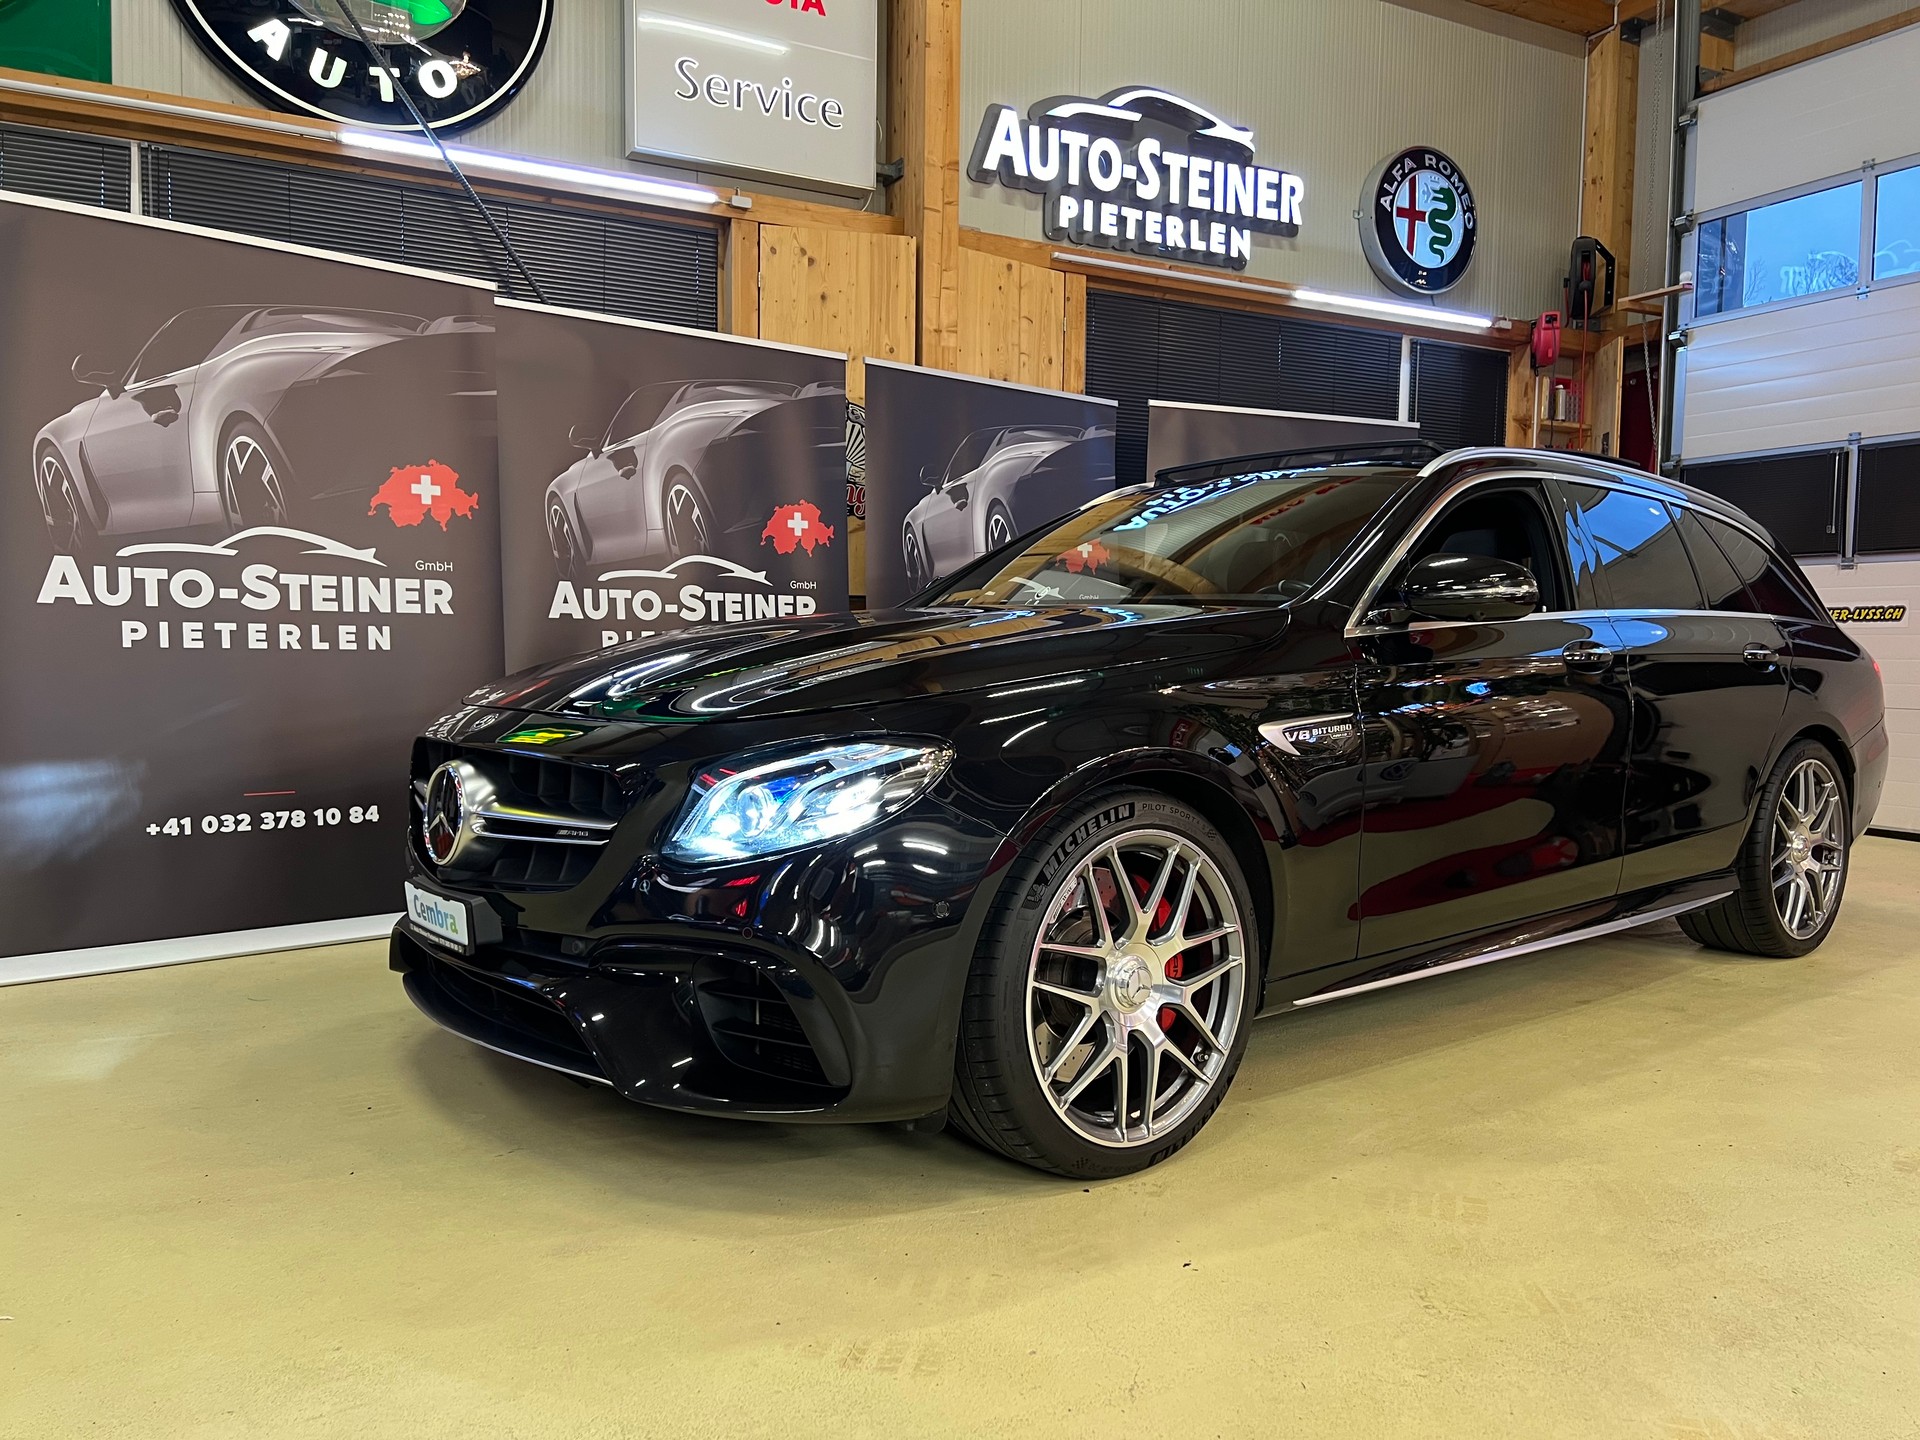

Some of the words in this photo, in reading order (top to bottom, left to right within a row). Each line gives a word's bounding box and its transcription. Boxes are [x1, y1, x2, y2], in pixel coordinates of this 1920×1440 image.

[247, 18, 458, 103] AUTO
[675, 56, 843, 130] Service
[982, 107, 1304, 226] AUTO-STEINER
[1380, 157, 1417, 212] ALFA
[1424, 154, 1474, 230] ROMEO
[1058, 196, 1252, 261] PIETERLEN
[36, 554, 455, 616] AUTO-STEINER
[415, 559, 454, 572] GmbH
[789, 580, 817, 590] GmbH
[121, 620, 391, 650] PIETERLEN
[1284, 730, 1310, 742] V8
[1312, 723, 1352, 736] BITURBO
[146, 816, 192, 837] +41
[202, 814, 251, 834] 032
[260, 810, 306, 831] 378
[313, 807, 342, 827] 10
[349, 805, 380, 824] 84
[1042, 804, 1130, 881] MICHELIN
[1142, 803, 1166, 812] PILOT
[1169, 807, 1197, 823] SPORT
[413, 894, 459, 935] Cembra
